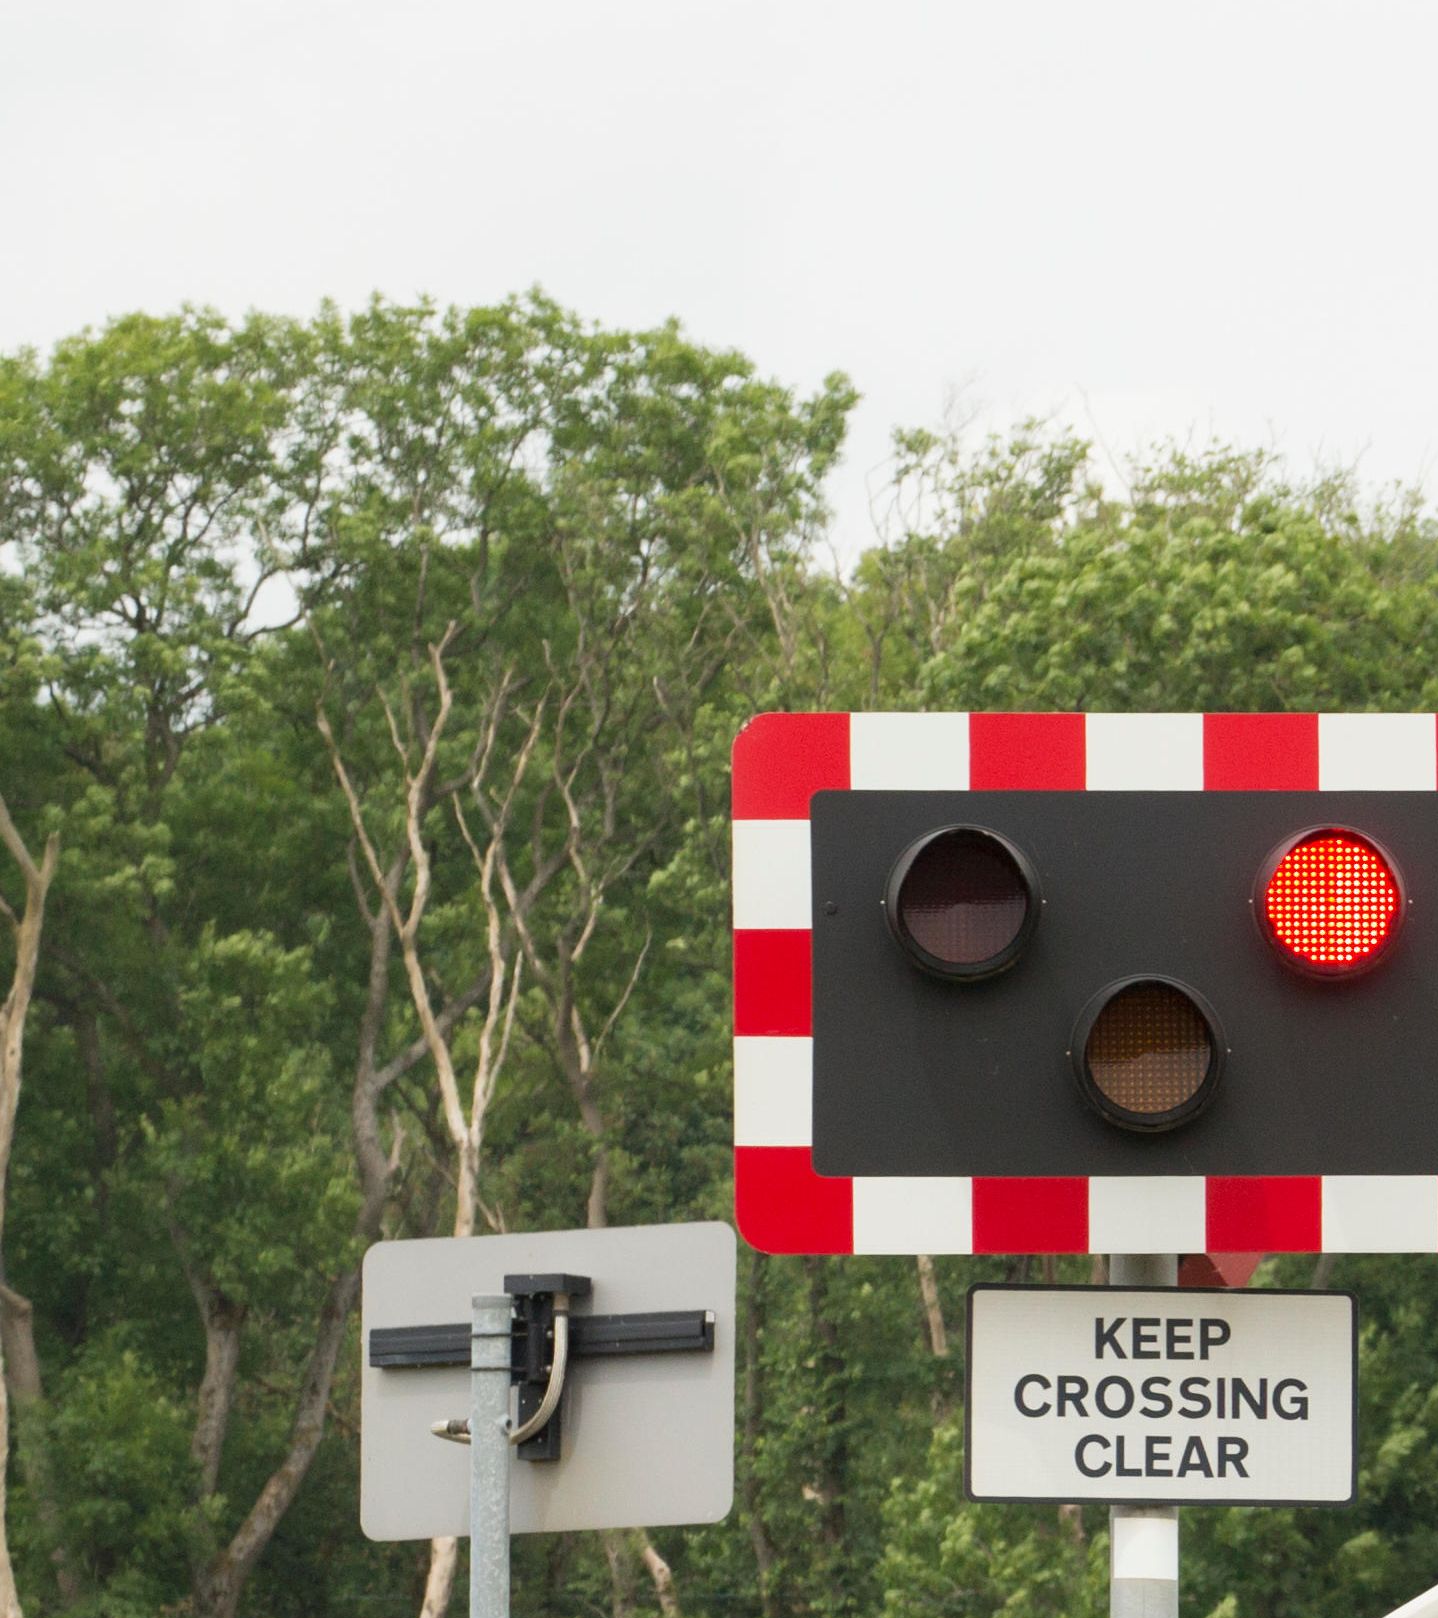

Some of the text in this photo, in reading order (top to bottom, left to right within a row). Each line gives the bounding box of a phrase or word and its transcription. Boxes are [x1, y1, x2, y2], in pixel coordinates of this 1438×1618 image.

[1095, 1318, 1231, 1360] KEEP
[1014, 1374, 1308, 1420] CROSSING
[1075, 1434, 1249, 1478] CLEAR
